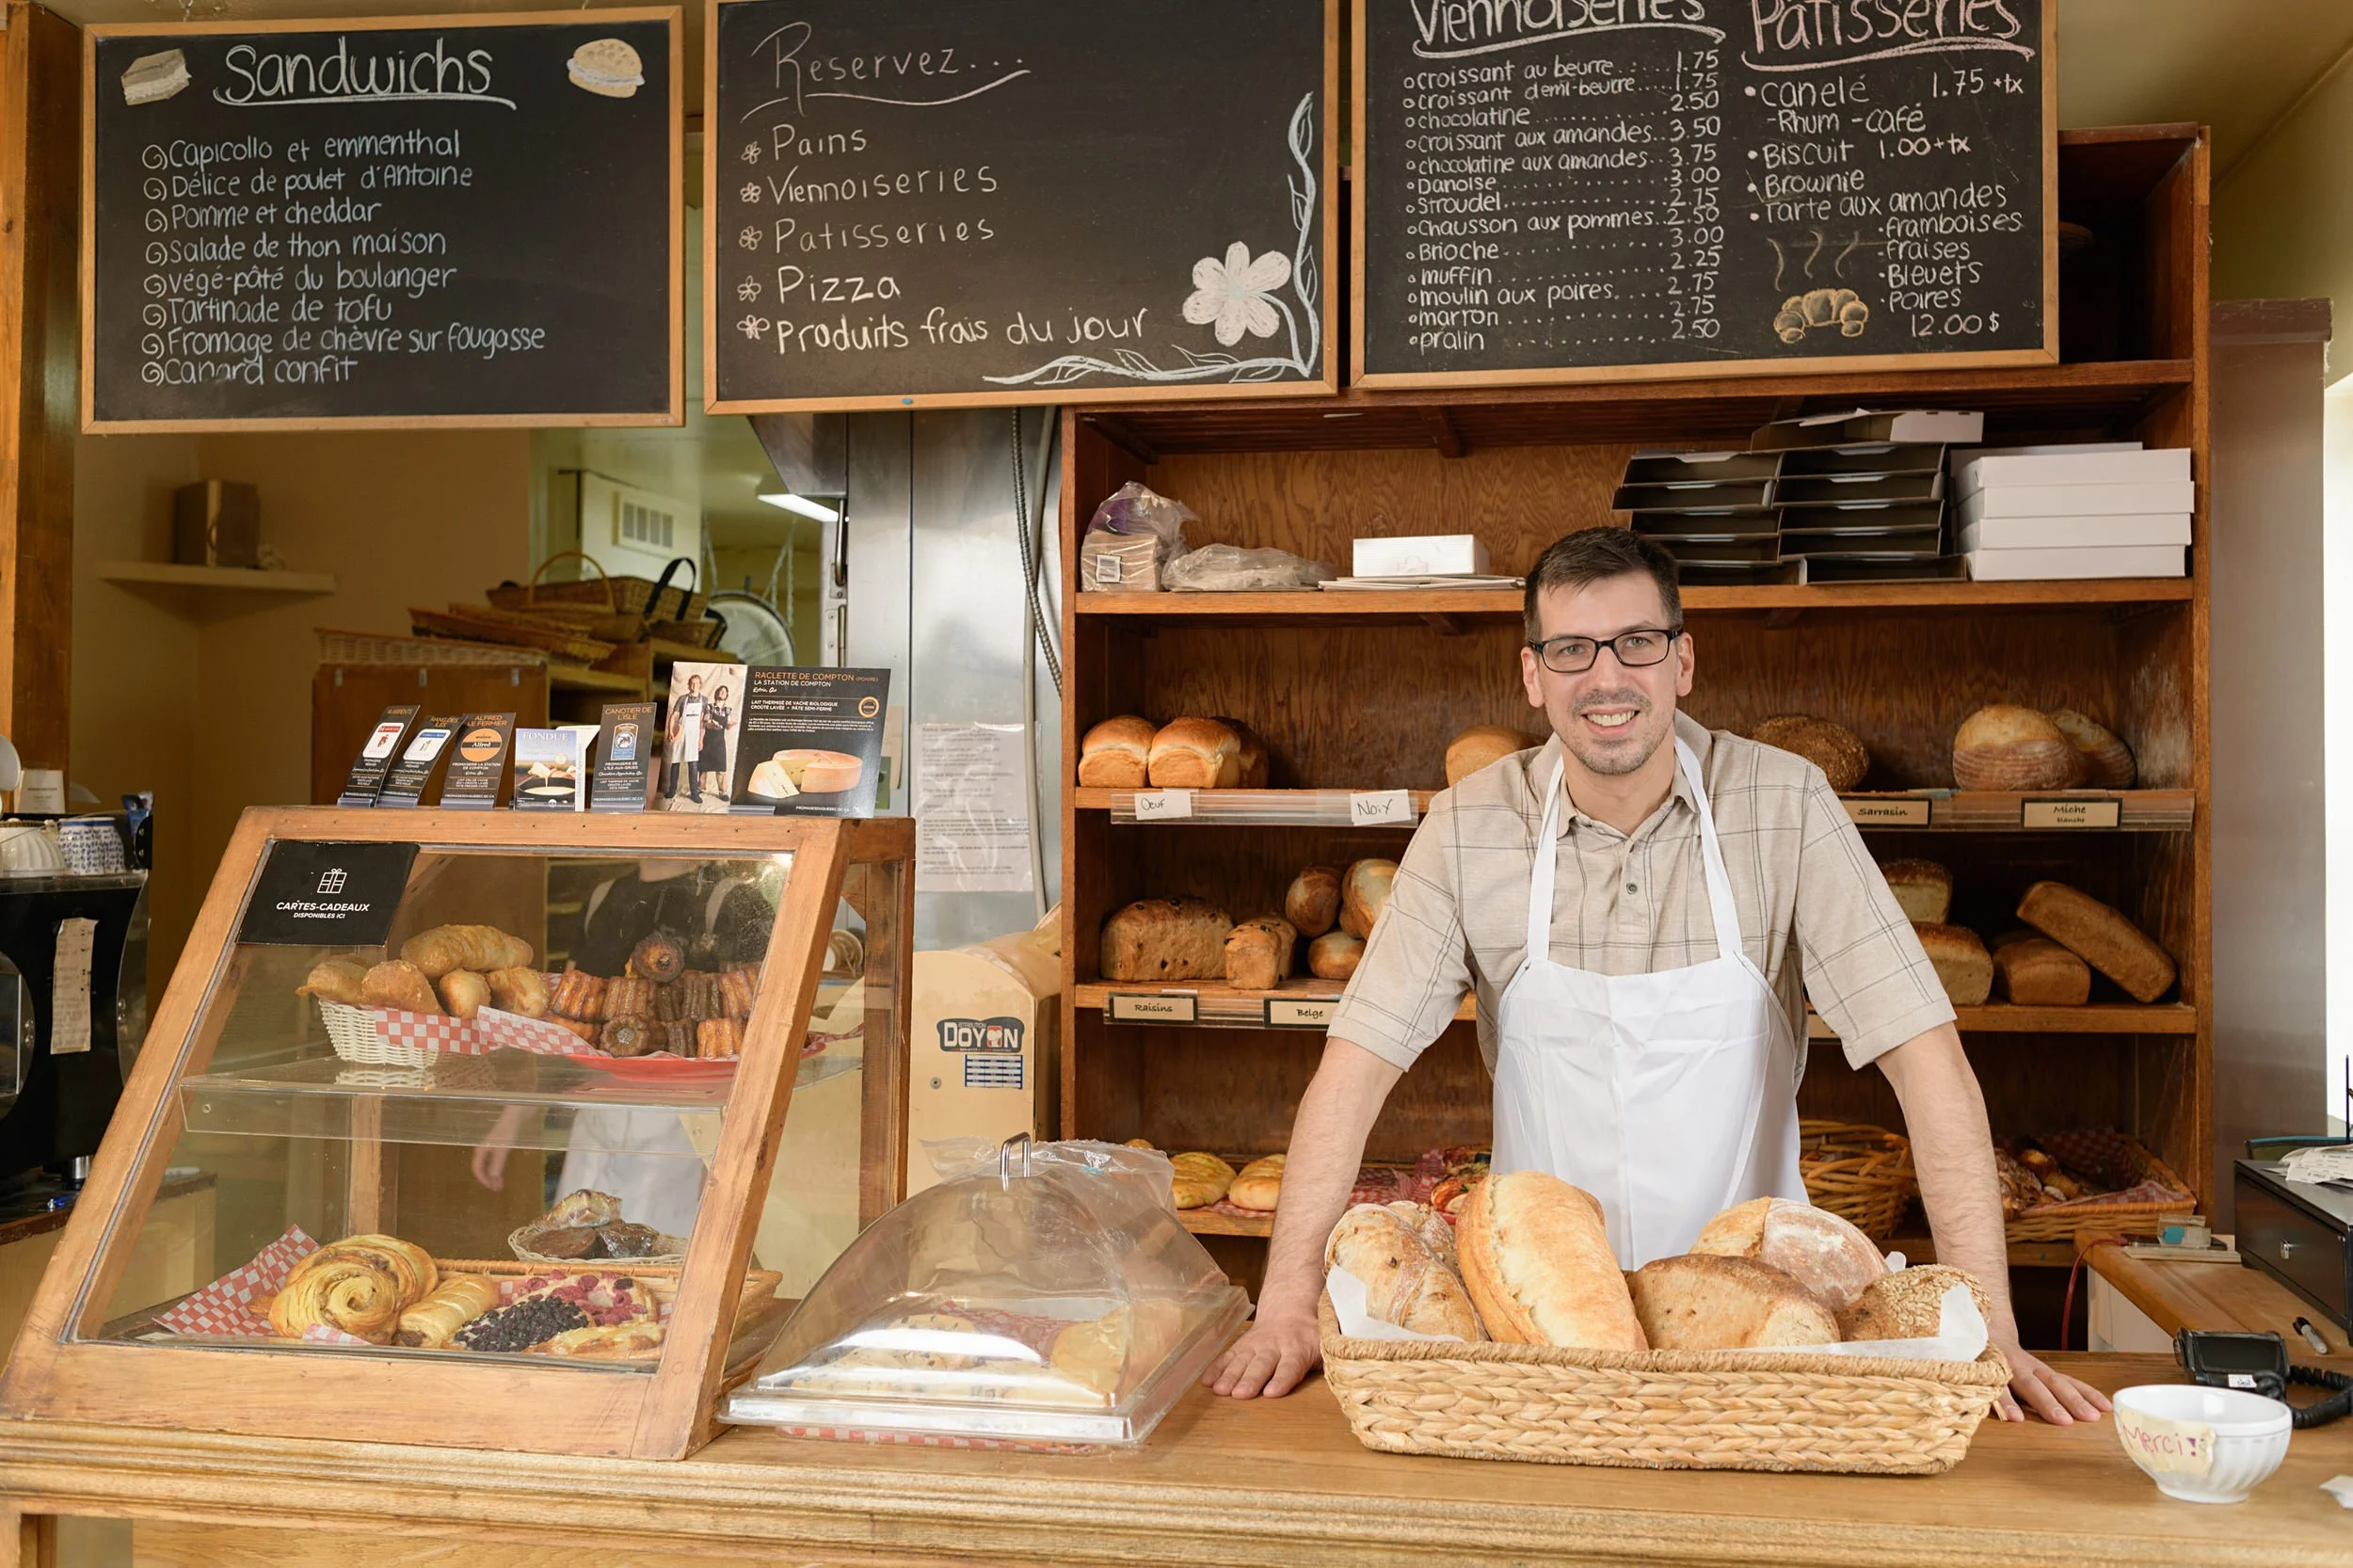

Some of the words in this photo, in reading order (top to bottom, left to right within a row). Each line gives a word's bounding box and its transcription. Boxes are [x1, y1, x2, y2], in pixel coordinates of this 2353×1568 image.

[225, 36, 493, 103] Sandwichs
[1417, 60, 1515, 90] croissant
[1524, 62, 1546, 78] au
[1554, 55, 1614, 76] beurre
[1675, 49, 1720, 72] 1.75
[1418, 88, 1513, 109] croissant
[1525, 76, 1636, 101] demi-beurre
[1675, 72, 1718, 91] 1.75
[1761, 74, 1869, 106] canelé
[1932, 68, 1983, 97] 1.75
[1418, 106, 1530, 130] chocolatine
[1671, 92, 1720, 112] 2.50
[169, 138, 272, 170] Capicollo
[287, 139, 310, 162] et
[324, 129, 460, 159] emmenthal
[773, 125, 867, 162] Pains
[1418, 131, 1506, 153] croissant
[1515, 130, 1545, 147] aux
[1554, 122, 1653, 144] amandes
[1669, 117, 1721, 142] 3.50
[1418, 154, 1515, 175] chocolatine
[1522, 153, 1552, 170] aux
[1559, 148, 1648, 169] amandes
[1669, 144, 1717, 168] 3.75
[1764, 139, 1854, 168] Biscuit
[172, 172, 241, 199] Délice
[250, 166, 276, 193] de
[284, 168, 345, 198] poulet
[767, 165, 998, 206] Viennoiseries
[1766, 168, 1865, 198] Brownie
[172, 202, 248, 230] Pomme
[256, 198, 277, 225] et
[284, 200, 382, 224] cheddar
[1418, 193, 1502, 215] Stroudel
[1669, 188, 1718, 207] 2.75
[1765, 198, 1832, 223] Tarte
[1840, 194, 1882, 216] aux
[1889, 183, 2007, 213] amandes
[776, 218, 995, 253] Patisseries
[1528, 214, 1560, 231] aux
[1568, 208, 1654, 239] pommes
[1667, 206, 1720, 226] 2.50
[169, 235, 246, 264] Salade
[253, 232, 279, 259] de
[289, 230, 341, 258] thon
[353, 229, 447, 255] maison
[1419, 240, 1498, 262] Brioche
[1671, 227, 1724, 248] 3.00
[1671, 250, 1721, 269] 2.25
[168, 264, 283, 297] végé-pâté
[296, 264, 323, 292] du
[337, 262, 458, 297] boulanger
[777, 264, 901, 305] Pizza
[1420, 285, 1488, 306] moulin
[1497, 288, 1536, 304] aux
[1547, 280, 1612, 308] poires
[1668, 272, 1718, 295] 2.75
[1888, 261, 1983, 288] Bleuets
[168, 296, 280, 325] Tartinade
[292, 296, 325, 324] de
[335, 294, 392, 324] tofu
[920, 307, 988, 343] frais
[1007, 311, 1054, 345] du
[1066, 307, 1148, 343] jour
[1419, 306, 1498, 328] marron
[1671, 296, 1716, 316] 2.75
[1912, 313, 1982, 336] 12.00
[1990, 312, 1999, 332] $
[168, 329, 274, 361] Fromage
[283, 327, 312, 352] de
[320, 326, 400, 353] chèvre
[409, 330, 443, 354] sur
[1420, 327, 1484, 356] pralin
[1672, 320, 1721, 340] 2.50
[812, 673, 855, 681] COMPTON
[523, 731, 568, 741] FONDUE
[1356, 798, 1393, 816] Noix
[1857, 808, 1908, 816] Sarrasin
[2053, 804, 2087, 815] Miche
[276, 902, 371, 912] CARTES-CADEAUX
[1134, 1003, 1173, 1013] Raisins
[1297, 1008, 1323, 1019] Belge
